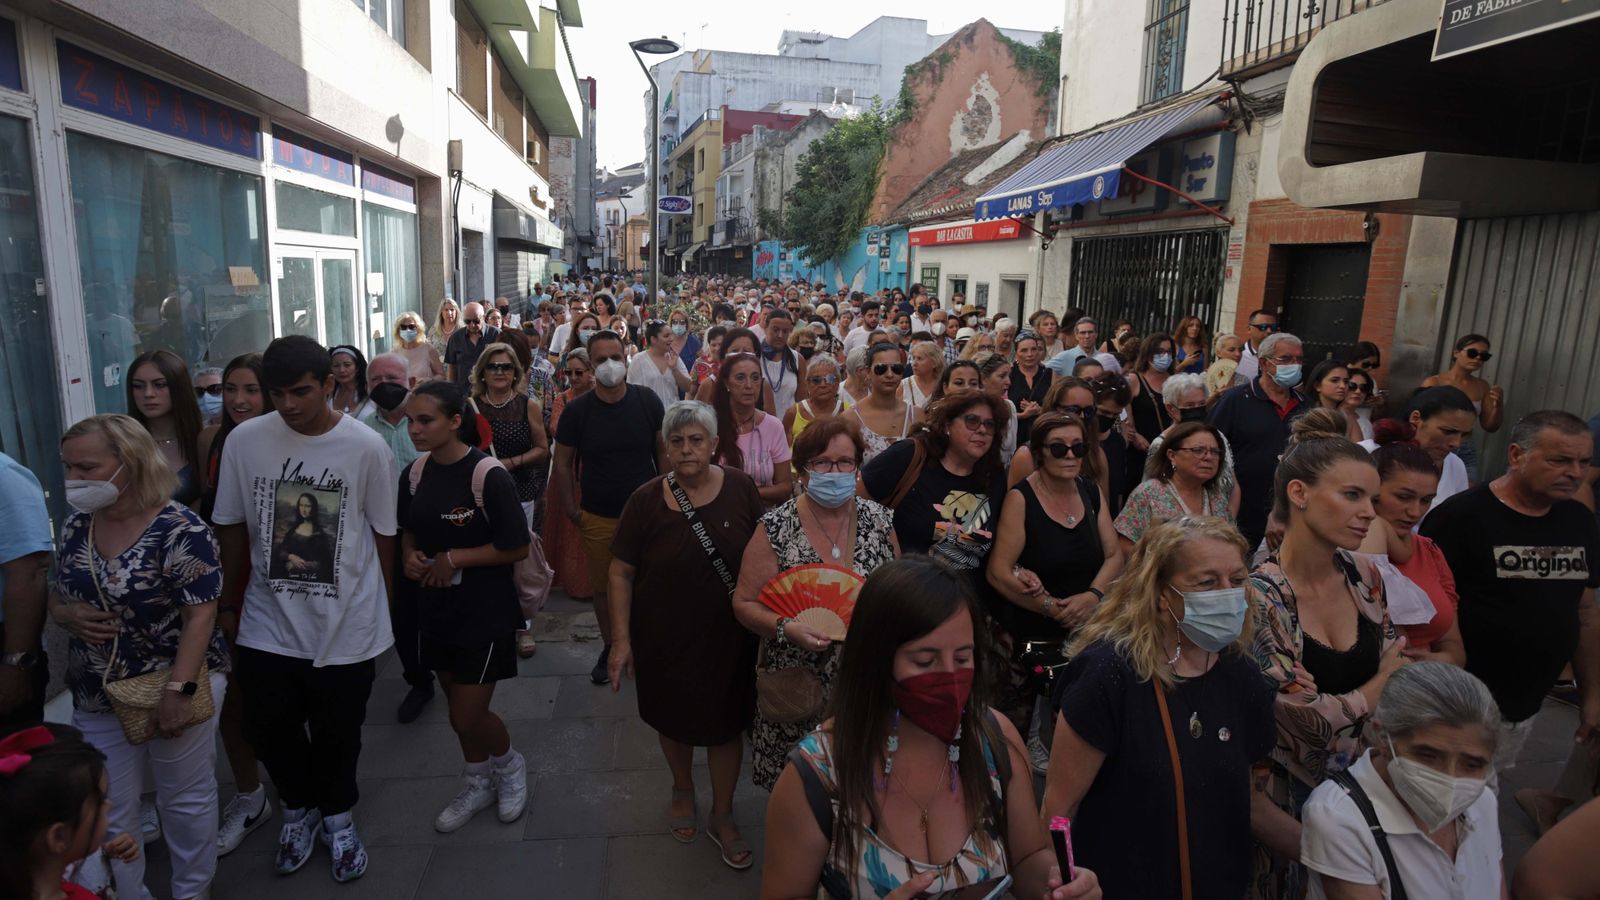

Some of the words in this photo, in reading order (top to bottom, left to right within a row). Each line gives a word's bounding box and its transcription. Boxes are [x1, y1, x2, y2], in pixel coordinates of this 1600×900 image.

[1450, 5, 1472, 24] DE
[73, 57, 252, 149] ZAPATOS
[279, 137, 346, 179] MODA
[1185, 174, 1207, 193] Sur
[1008, 195, 1032, 212] LANAS
[1038, 191, 1054, 207] Stop
[936, 229, 946, 243] BAR
[947, 228, 954, 241] LA
[673, 487, 696, 520] BIMBA
[692, 521, 716, 556] BIMBA
[712, 558, 735, 591] BIMBA
